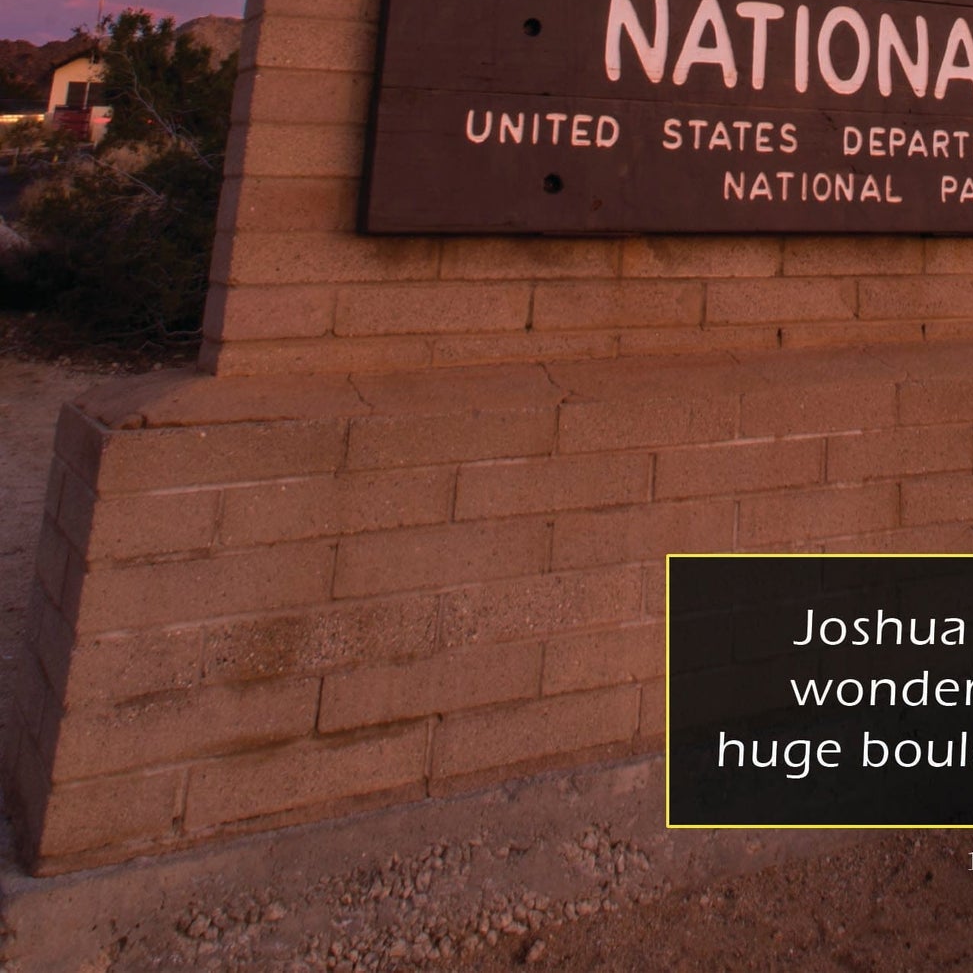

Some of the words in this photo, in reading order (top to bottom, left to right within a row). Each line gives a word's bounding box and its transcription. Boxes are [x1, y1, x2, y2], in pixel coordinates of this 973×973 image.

[467, 110, 619, 147] UNITED
[663, 119, 797, 153] STATES
[724, 171, 902, 203] NATIONAL
